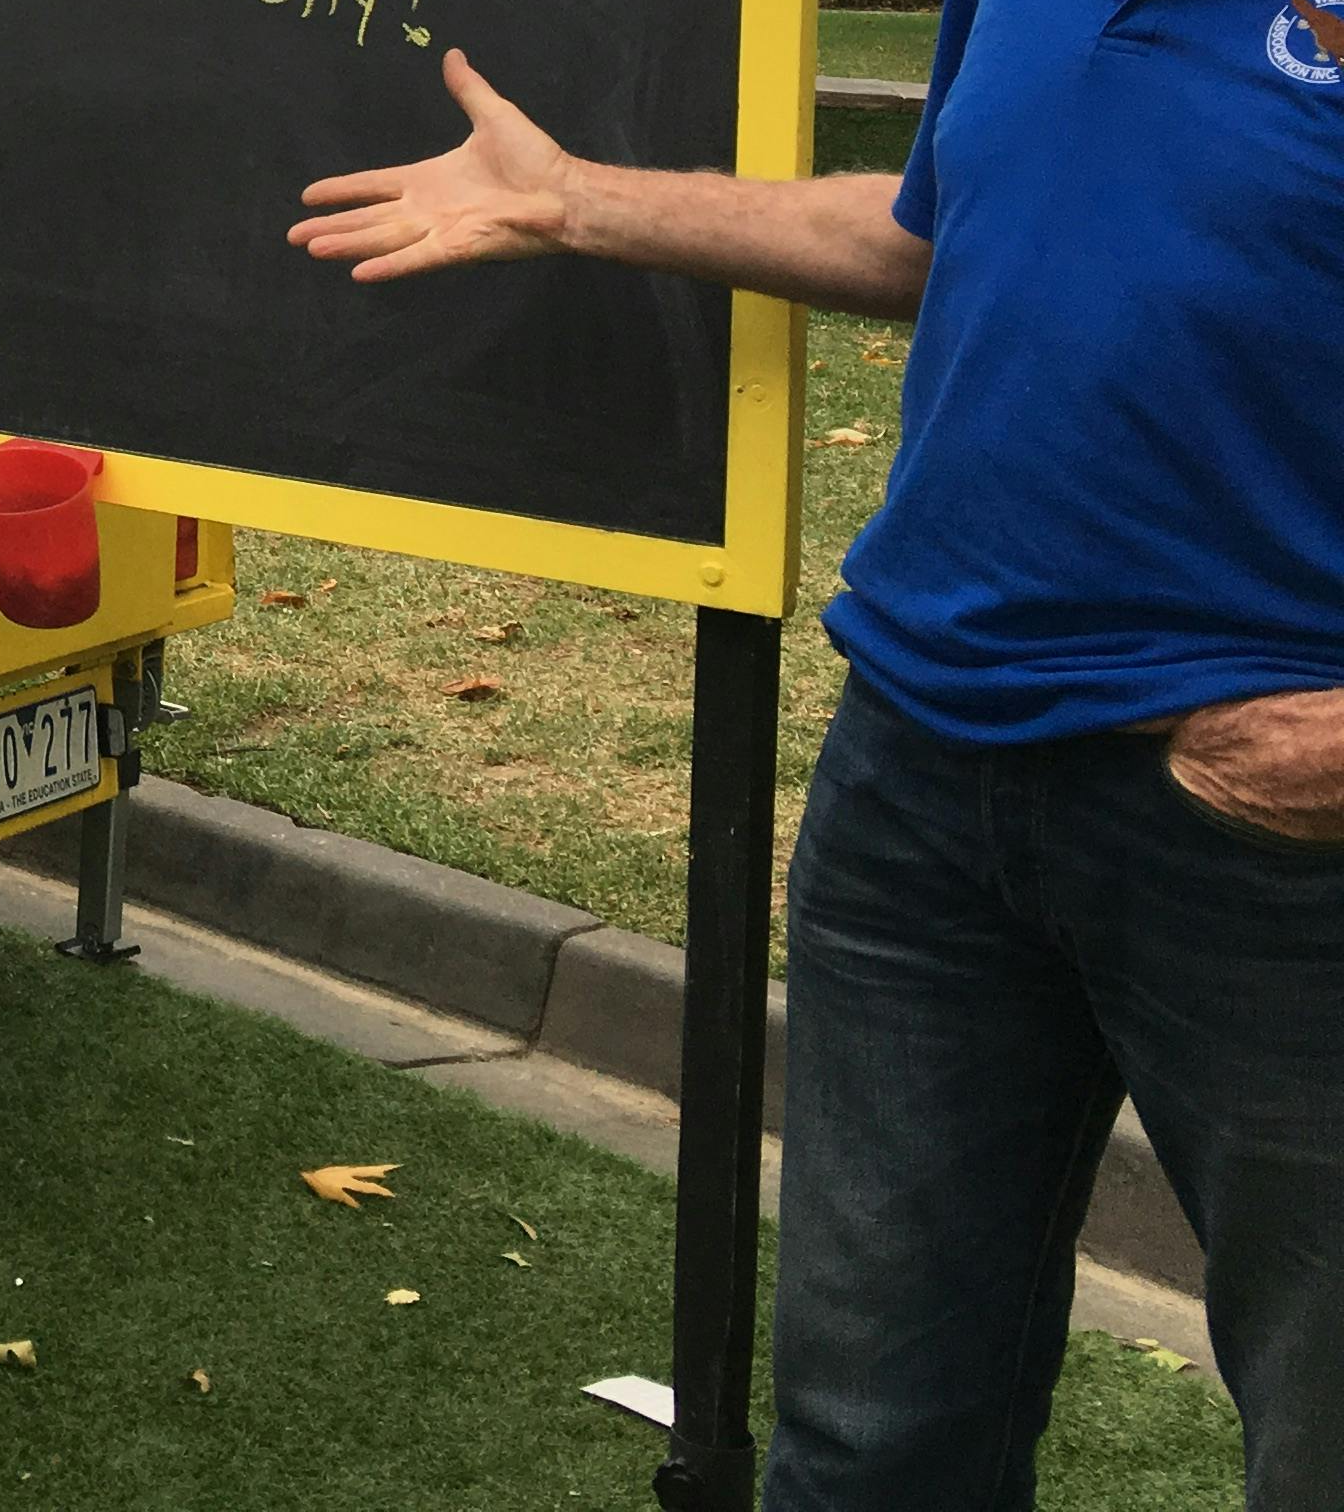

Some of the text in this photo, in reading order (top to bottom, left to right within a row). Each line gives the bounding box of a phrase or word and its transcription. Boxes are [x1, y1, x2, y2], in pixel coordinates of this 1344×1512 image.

[41, 701, 92, 777] 277
[12, 794, 26, 808] THE
[28, 778, 71, 802] EDUCATION
[72, 769, 93, 786] STATE
